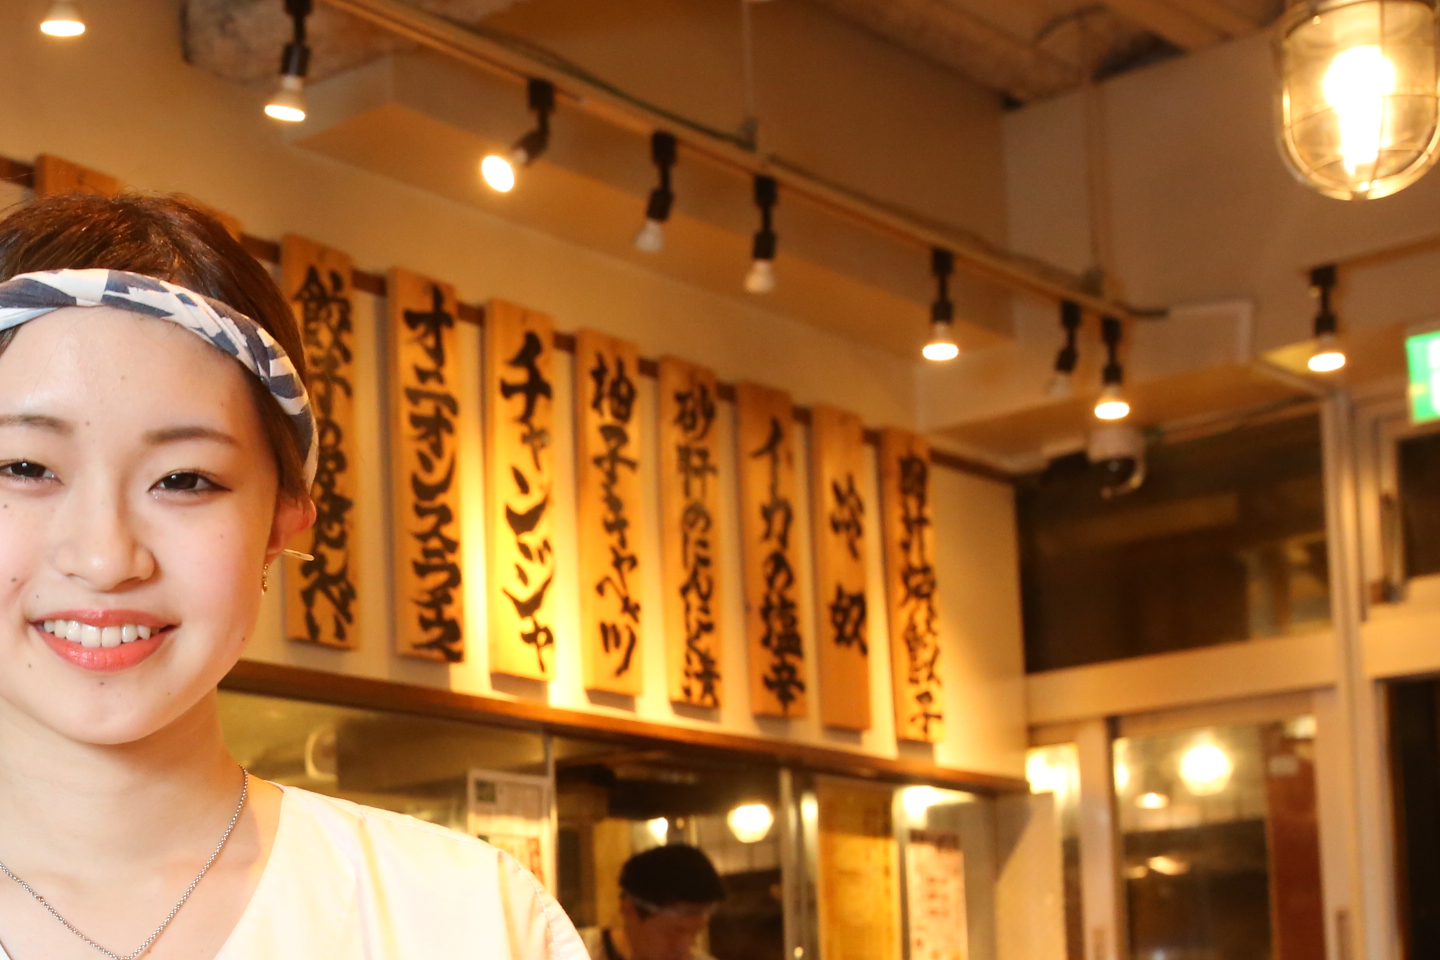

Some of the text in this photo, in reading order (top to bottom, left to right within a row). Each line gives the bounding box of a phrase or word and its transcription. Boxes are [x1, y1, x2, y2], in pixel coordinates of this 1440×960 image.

[500, 331, 553, 672] チャンジャ
